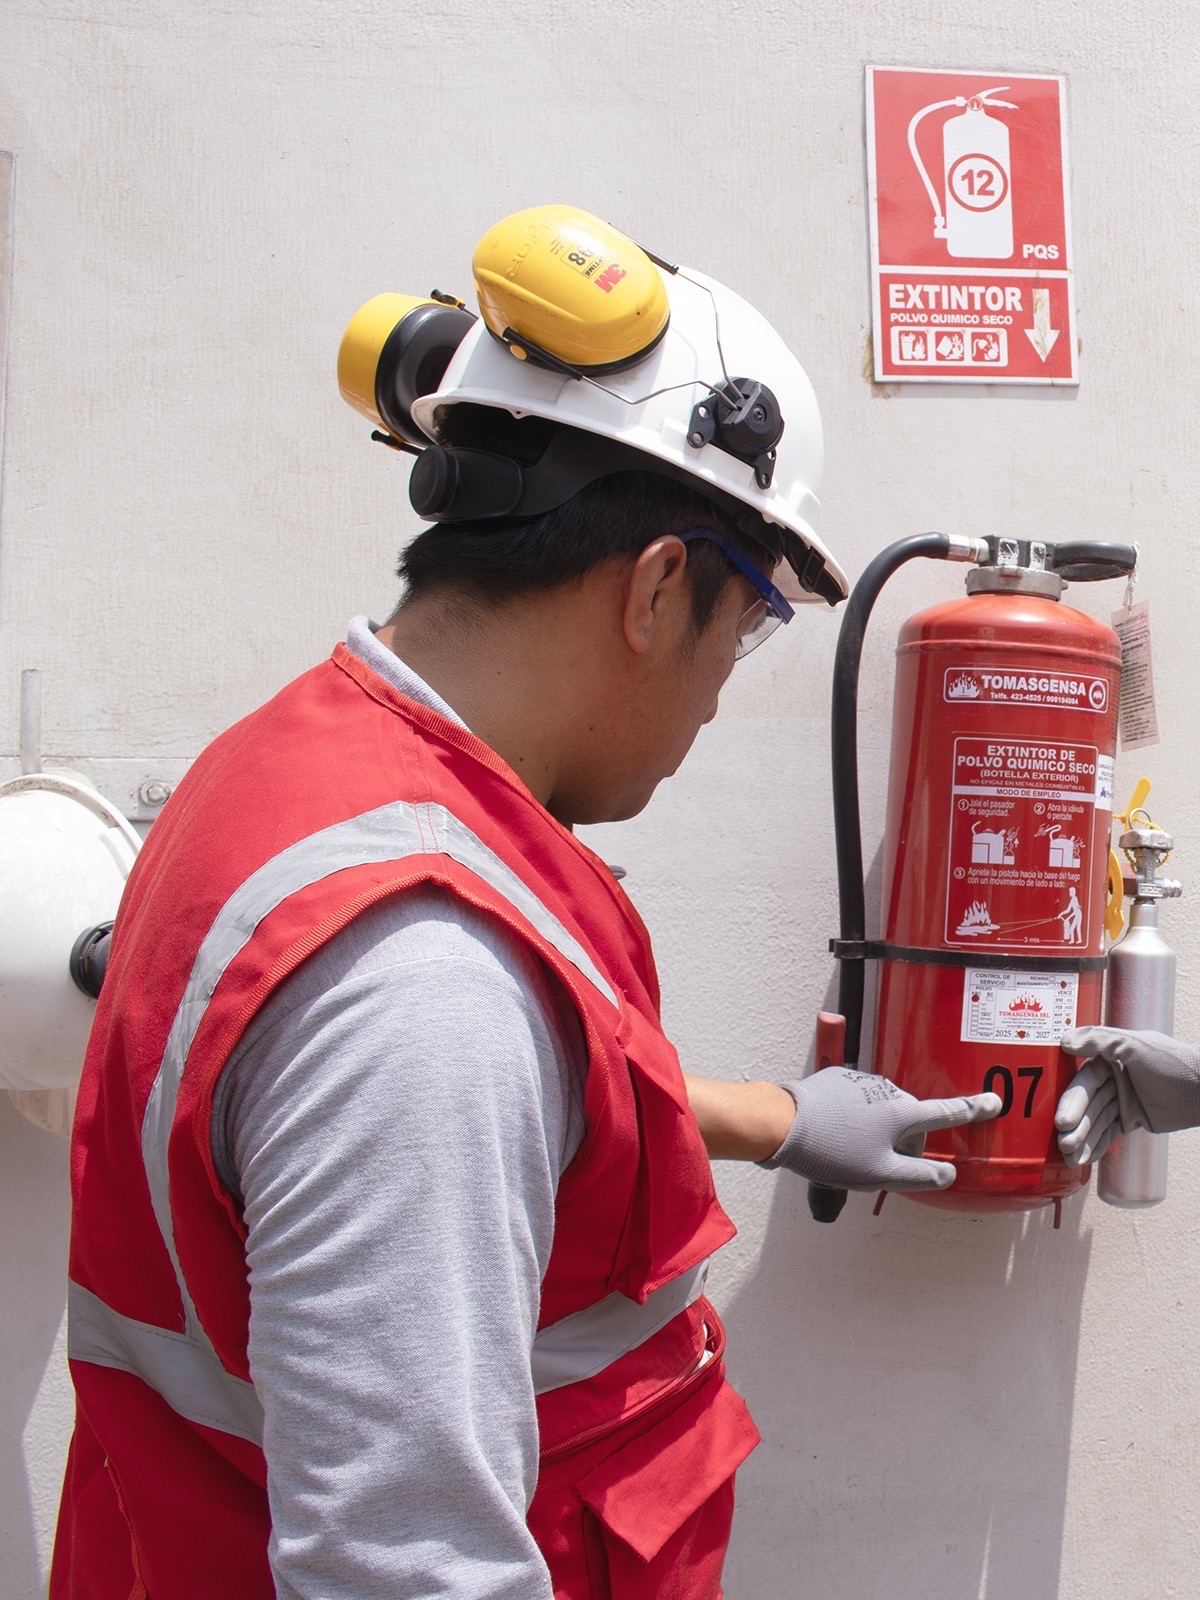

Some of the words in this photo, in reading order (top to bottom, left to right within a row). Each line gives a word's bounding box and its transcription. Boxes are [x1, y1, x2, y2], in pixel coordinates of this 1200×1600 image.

[961, 169, 995, 196] 12
[1022, 244, 1059, 260] PQS
[594, 262, 627, 294] 3M
[888, 283, 1023, 312] EXTINTOR
[890, 313, 928, 324] POLVO
[930, 314, 980, 325] QUIMICO
[982, 314, 1013, 326] SECO
[981, 674, 1087, 696] TOMASGENSA
[990, 692, 1009, 700] Telfs.
[987, 745, 1057, 760] EXTINTOR
[1060, 750, 1076, 761] DE
[957, 756, 1003, 768] POLVO
[1009, 758, 1066, 772] QUIMICO
[1069, 763, 1095, 775] SECO
[980, 769, 1030, 779] (BOTELLA
[1032, 772, 1079, 784] EXTERIOR)
[1015, 781, 1046, 789] METALES
[996, 788, 1018, 796] MODO
[1032, 790, 1061, 799] EMPLEO
[969, 799, 981, 808] Jale
[983, 800, 989, 808] el
[990, 801, 1015, 810] pasador
[969, 807, 977, 815] de
[1047, 803, 1061, 811] Abra
[991, 868, 997, 876] la
[999, 869, 1018, 878] pistola
[1020, 869, 1036, 878] hacia
[1044, 871, 1058, 880] base
[990, 878, 1025, 887] movimiento
[1026, 879, 1034, 887] de
[1035, 879, 1047, 888] lado
[983, 1065, 1043, 1118] 07
